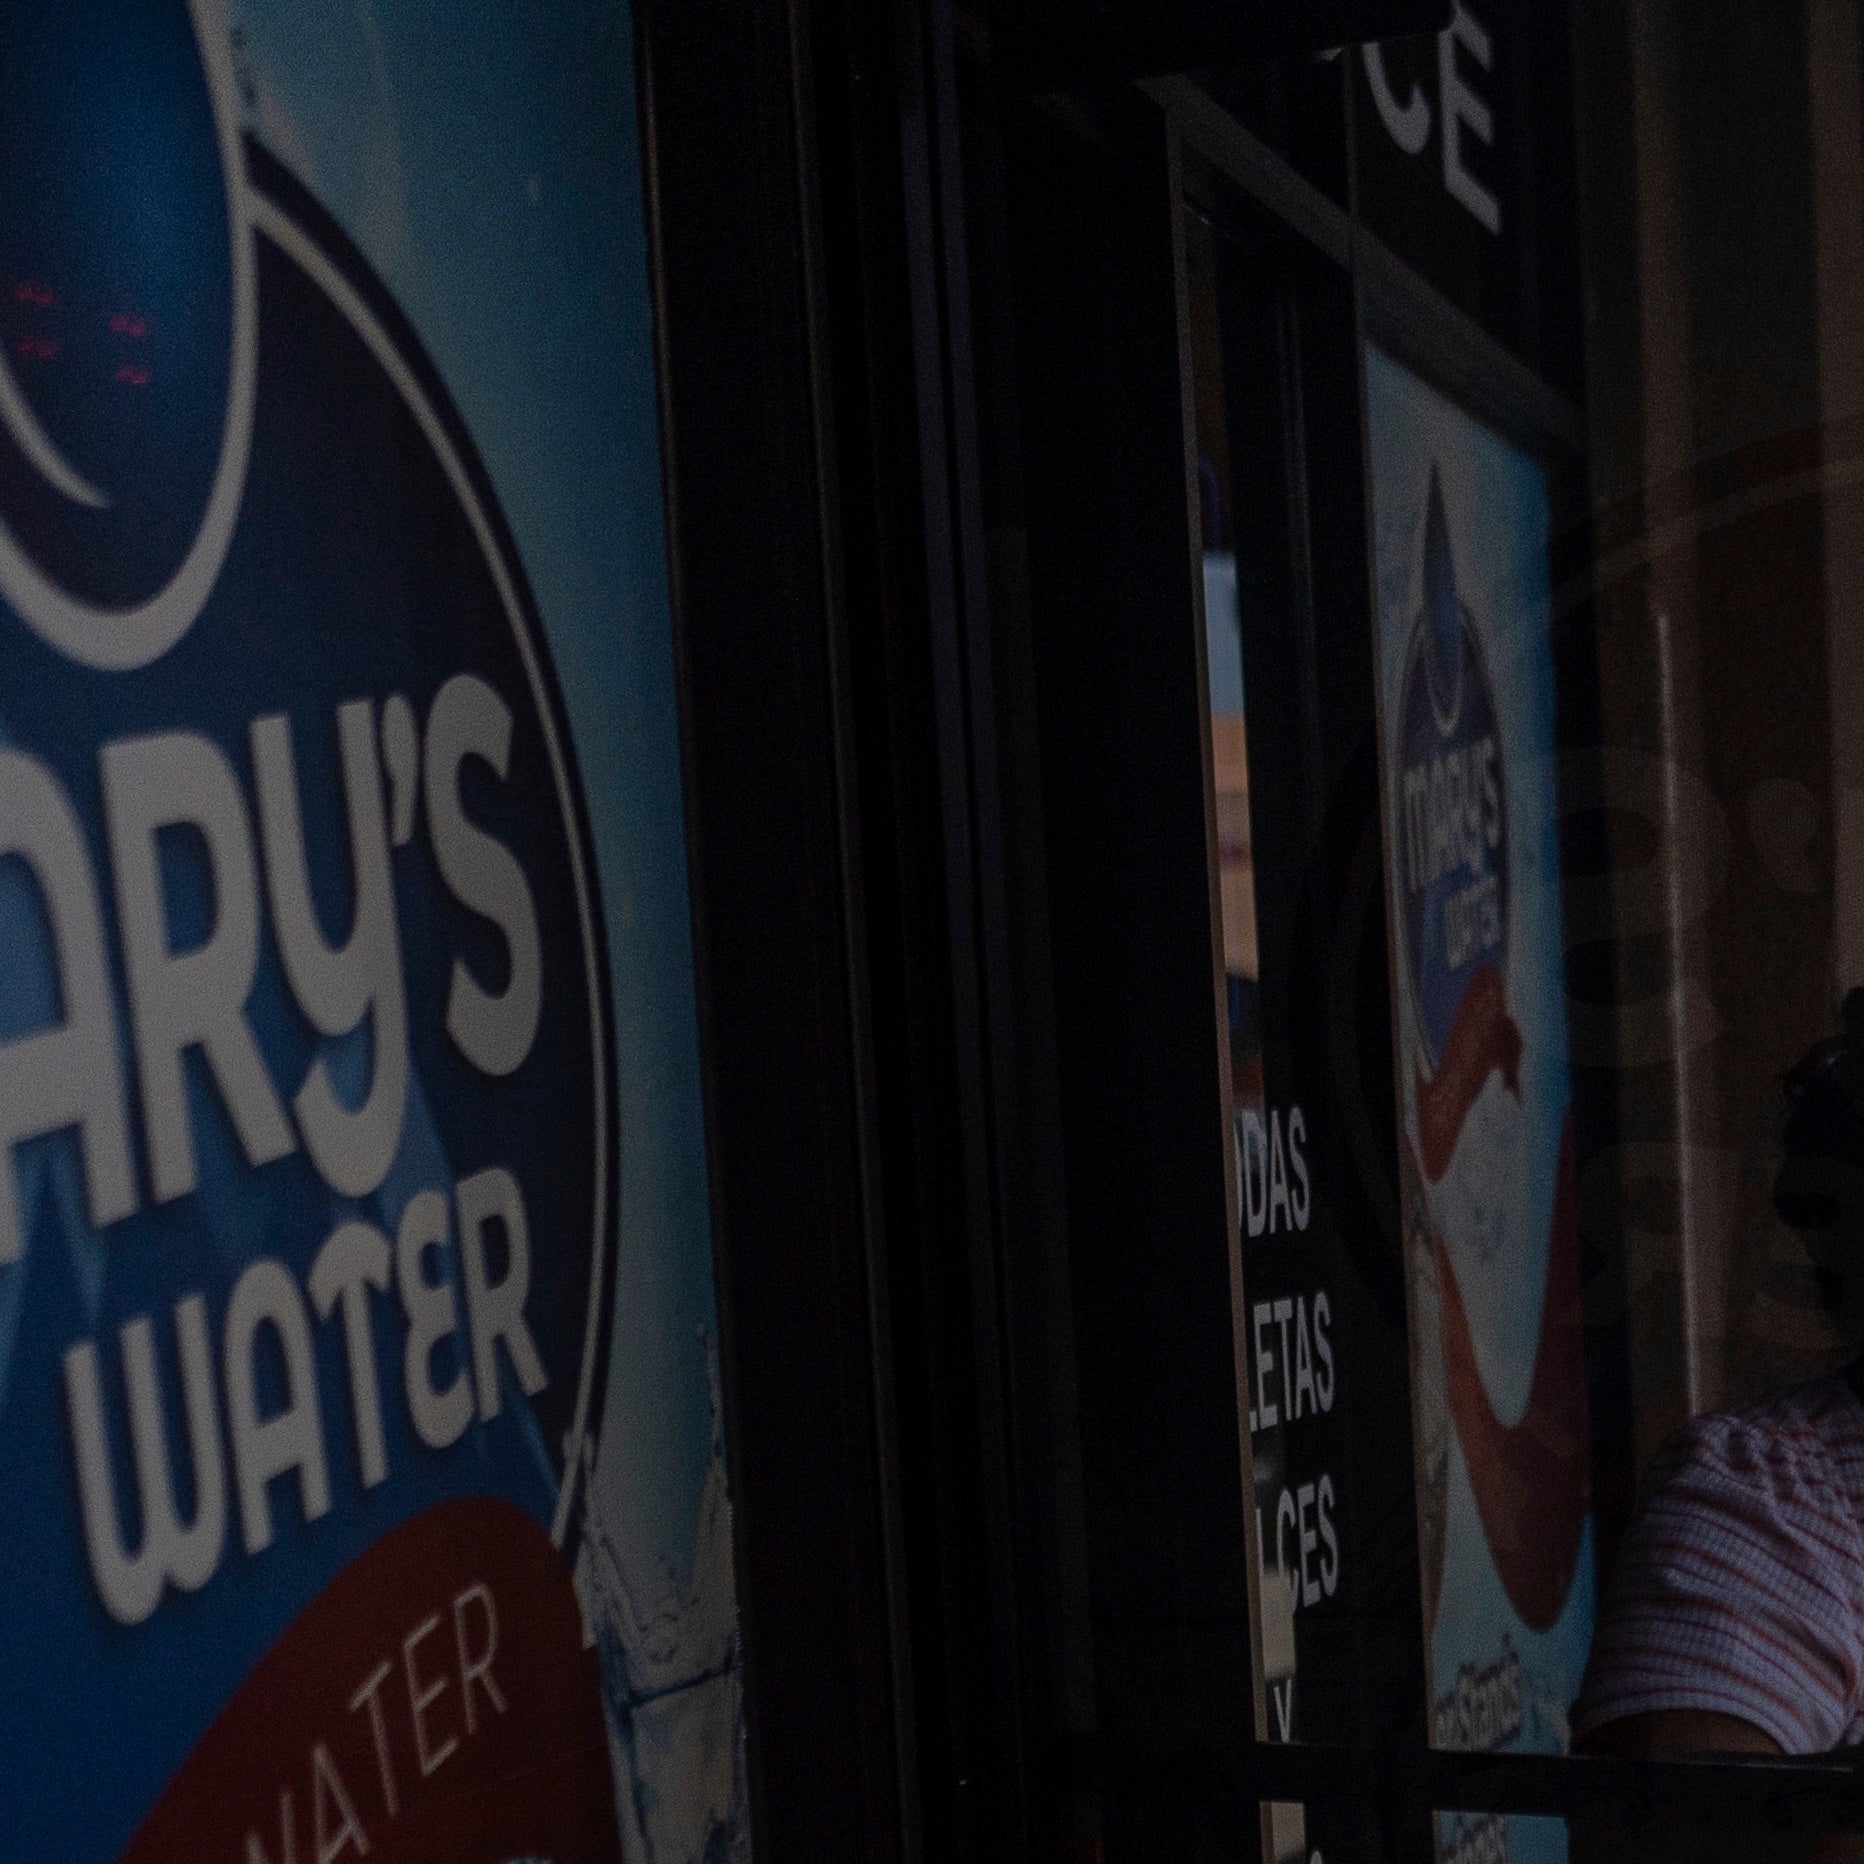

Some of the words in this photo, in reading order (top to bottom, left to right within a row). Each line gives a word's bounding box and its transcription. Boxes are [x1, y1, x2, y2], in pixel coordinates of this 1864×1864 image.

[62, 1166, 549, 1627] WATER
[1249, 1290, 1335, 1433] ETAS
[1257, 1472, 1340, 1618] CES
